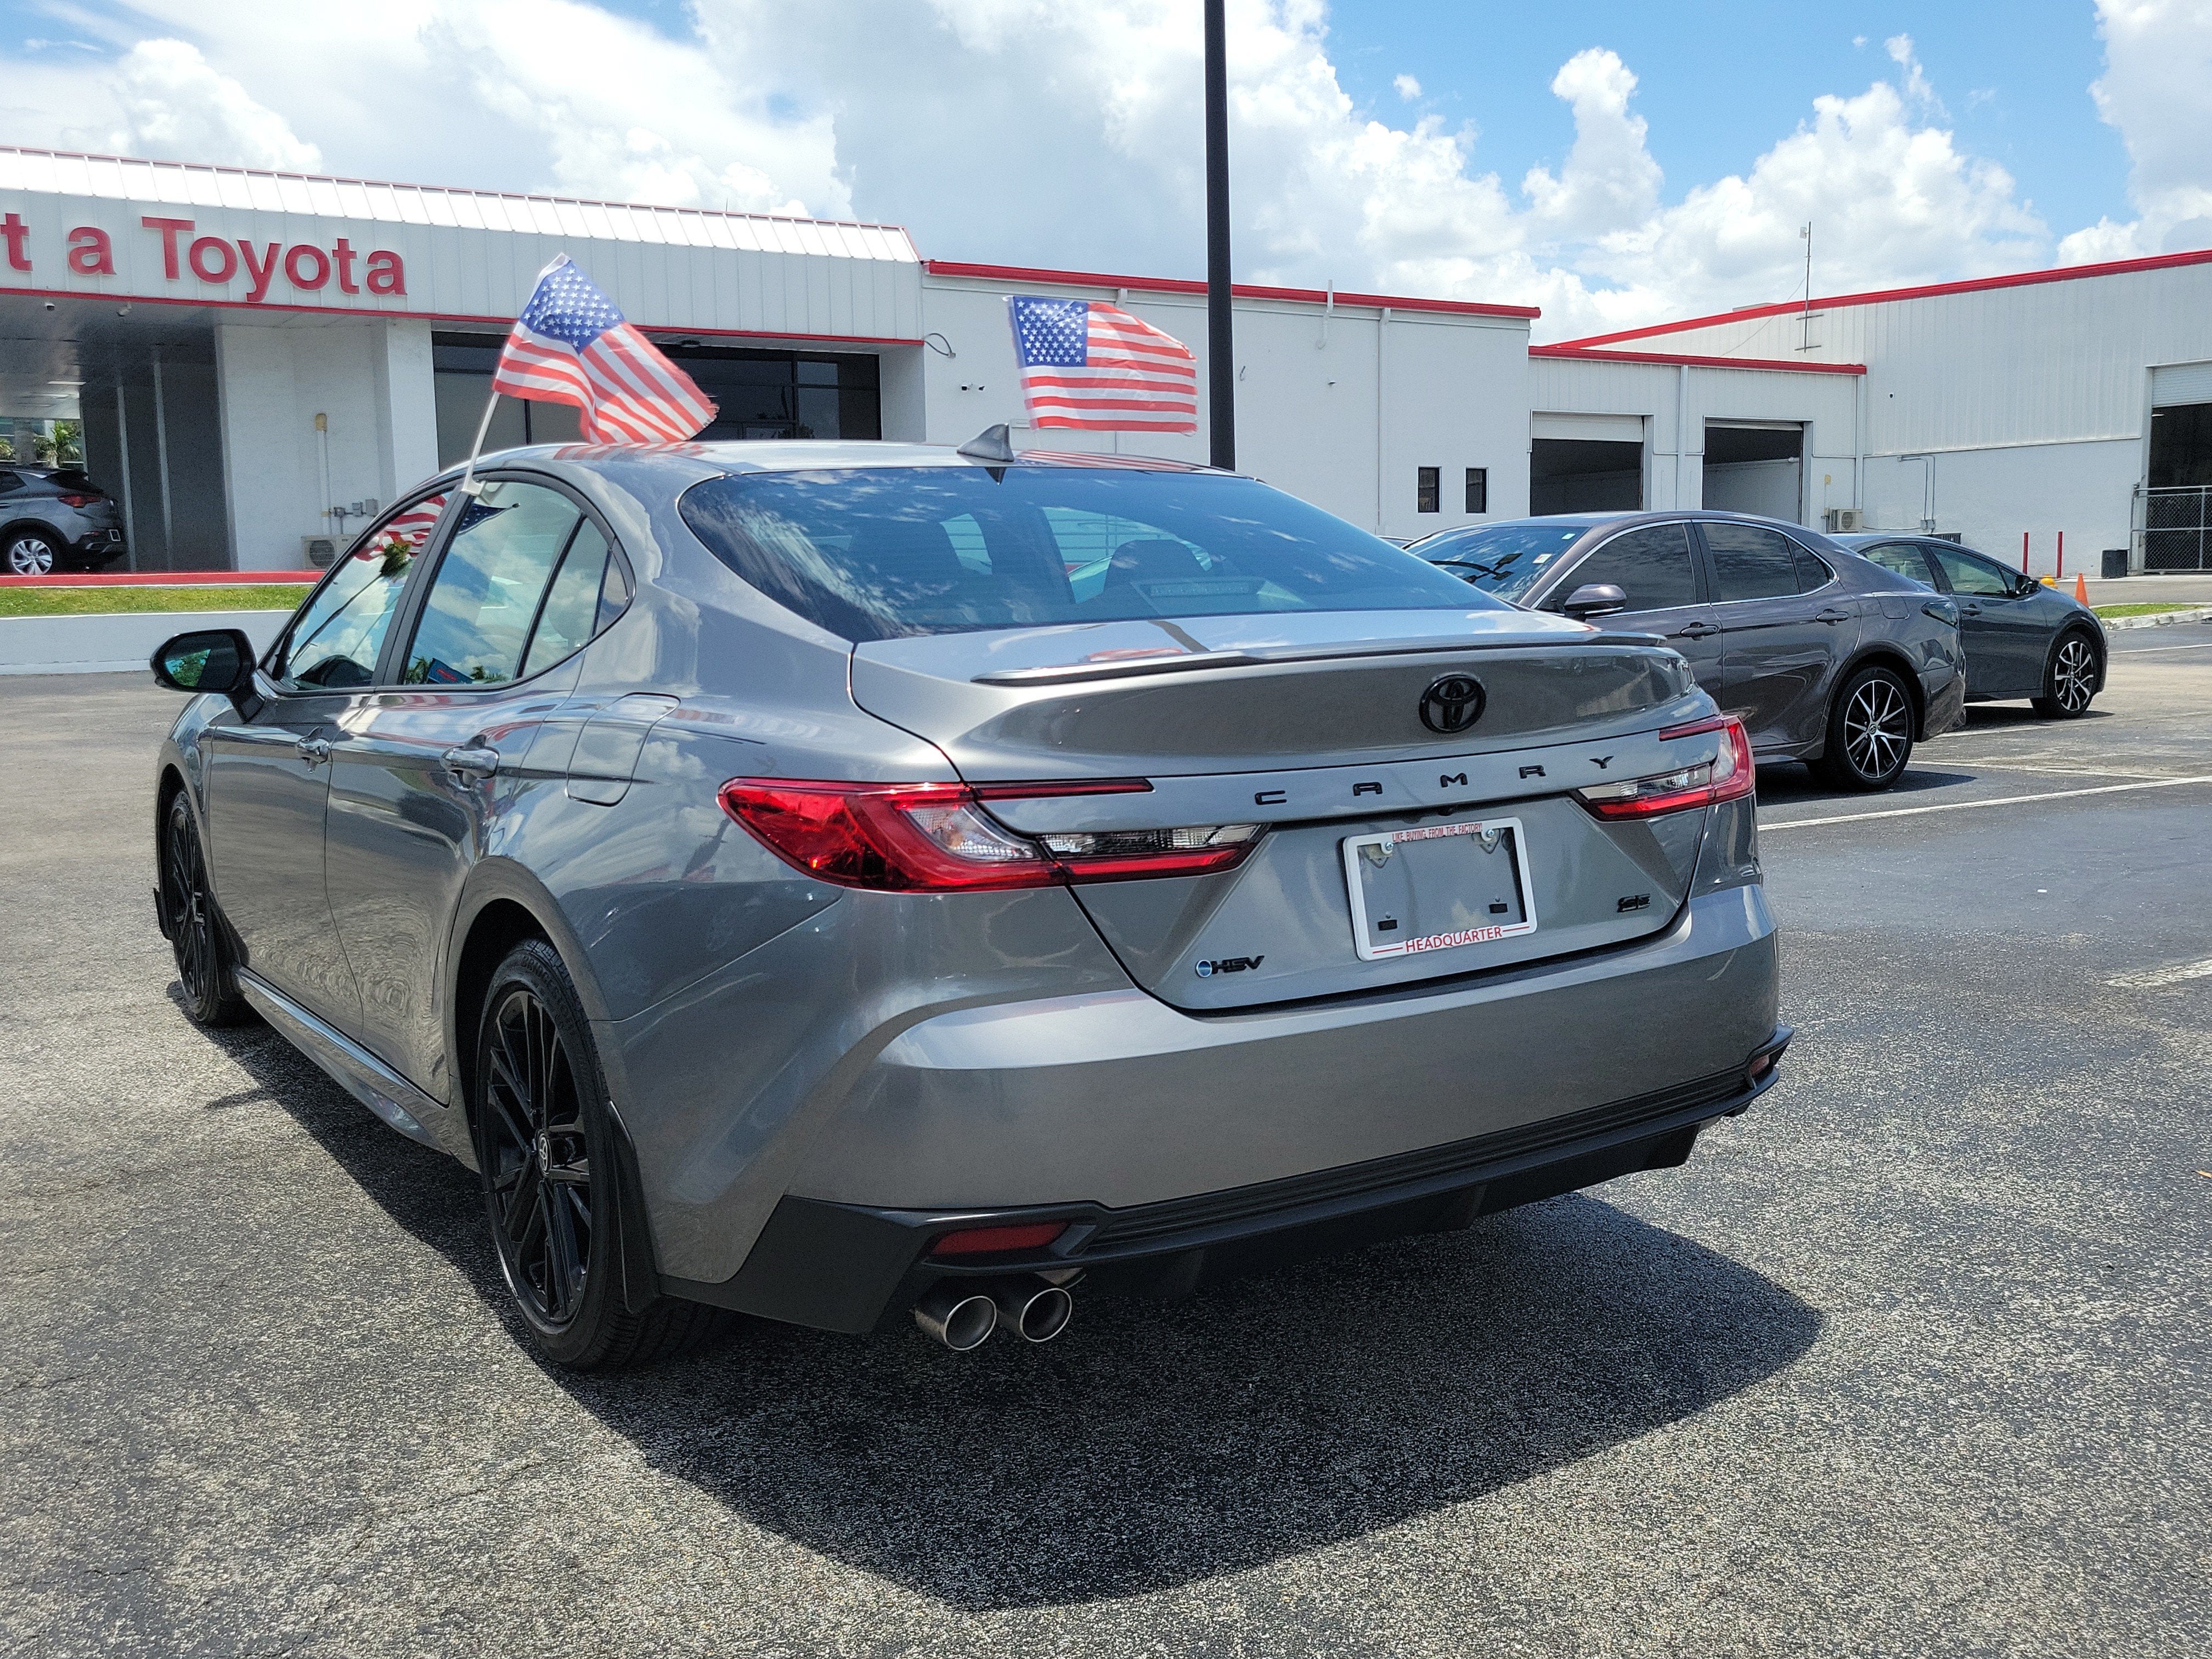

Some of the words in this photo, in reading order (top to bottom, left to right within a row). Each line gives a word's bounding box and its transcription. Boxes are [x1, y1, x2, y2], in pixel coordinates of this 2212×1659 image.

[67, 226, 116, 275] a
[141, 215, 408, 303] Toyota
[1255, 755, 1615, 805] CAMRY
[1392, 832, 1403, 842] LIKE
[1406, 830, 1426, 842] BUYING
[1429, 827, 1444, 839] FROM
[1446, 826, 1456, 837] THE
[1406, 927, 1503, 952] HEADQUARTER
[1210, 955, 1265, 974] HEV
